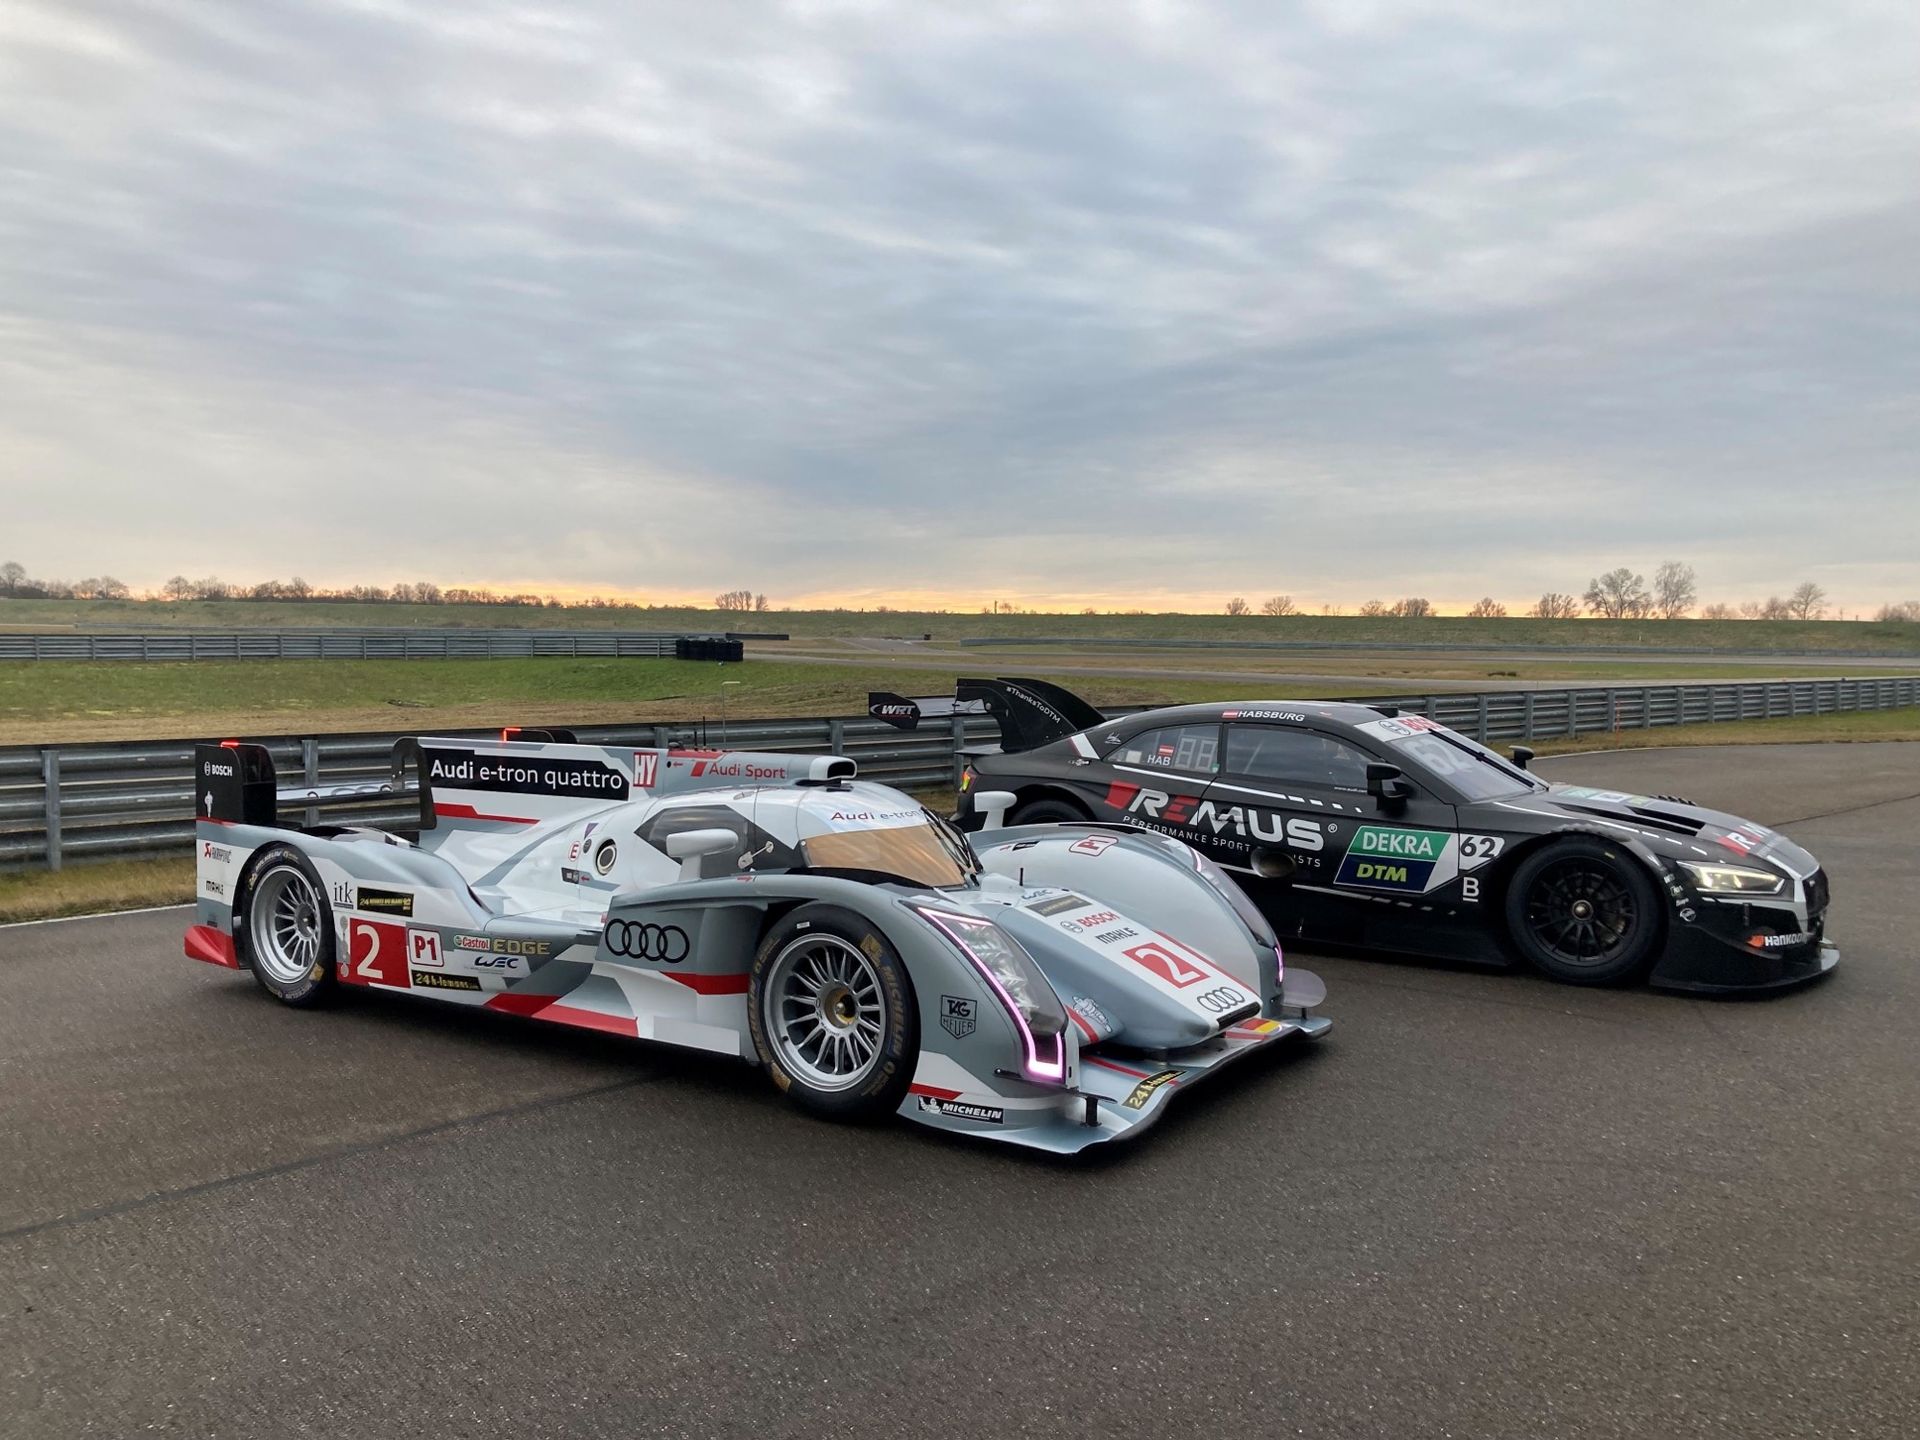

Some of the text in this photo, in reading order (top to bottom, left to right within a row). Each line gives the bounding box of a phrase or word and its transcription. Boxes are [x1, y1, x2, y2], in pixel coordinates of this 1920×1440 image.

[881, 705, 916, 715] WRT
[1006, 686, 1061, 724] #ThanksToDTM
[1237, 710, 1306, 722] HABSBURG
[1147, 754, 1171, 766] HAB
[211, 764, 233, 776] BOSCH
[431, 760, 623, 790] Audi e-tron quattro
[634, 754, 658, 786] HY
[709, 762, 785, 780] Audi Sport
[831, 811, 875, 821] Audi
[1128, 788, 1324, 851] REMUS
[1122, 815, 1251, 852] PERFORMANCE SPORT
[1077, 839, 1109, 850] P1
[1362, 831, 1434, 856] DEKRA
[1460, 836, 1496, 858] 62
[1356, 864, 1407, 882] DTM
[334, 881, 353, 904] itk
[1075, 911, 1121, 928] BOSCH
[1095, 927, 1139, 944] MAHLE
[356, 924, 384, 980] 2
[414, 935, 437, 961] P1
[462, 936, 551, 955] Castrol EDGE
[474, 956, 519, 969] WEC
[1135, 948, 1201, 984] 2
[947, 999, 971, 1017] TAG
[943, 1018, 974, 1037] HEUER
[942, 1102, 1003, 1119] MICHELIN
